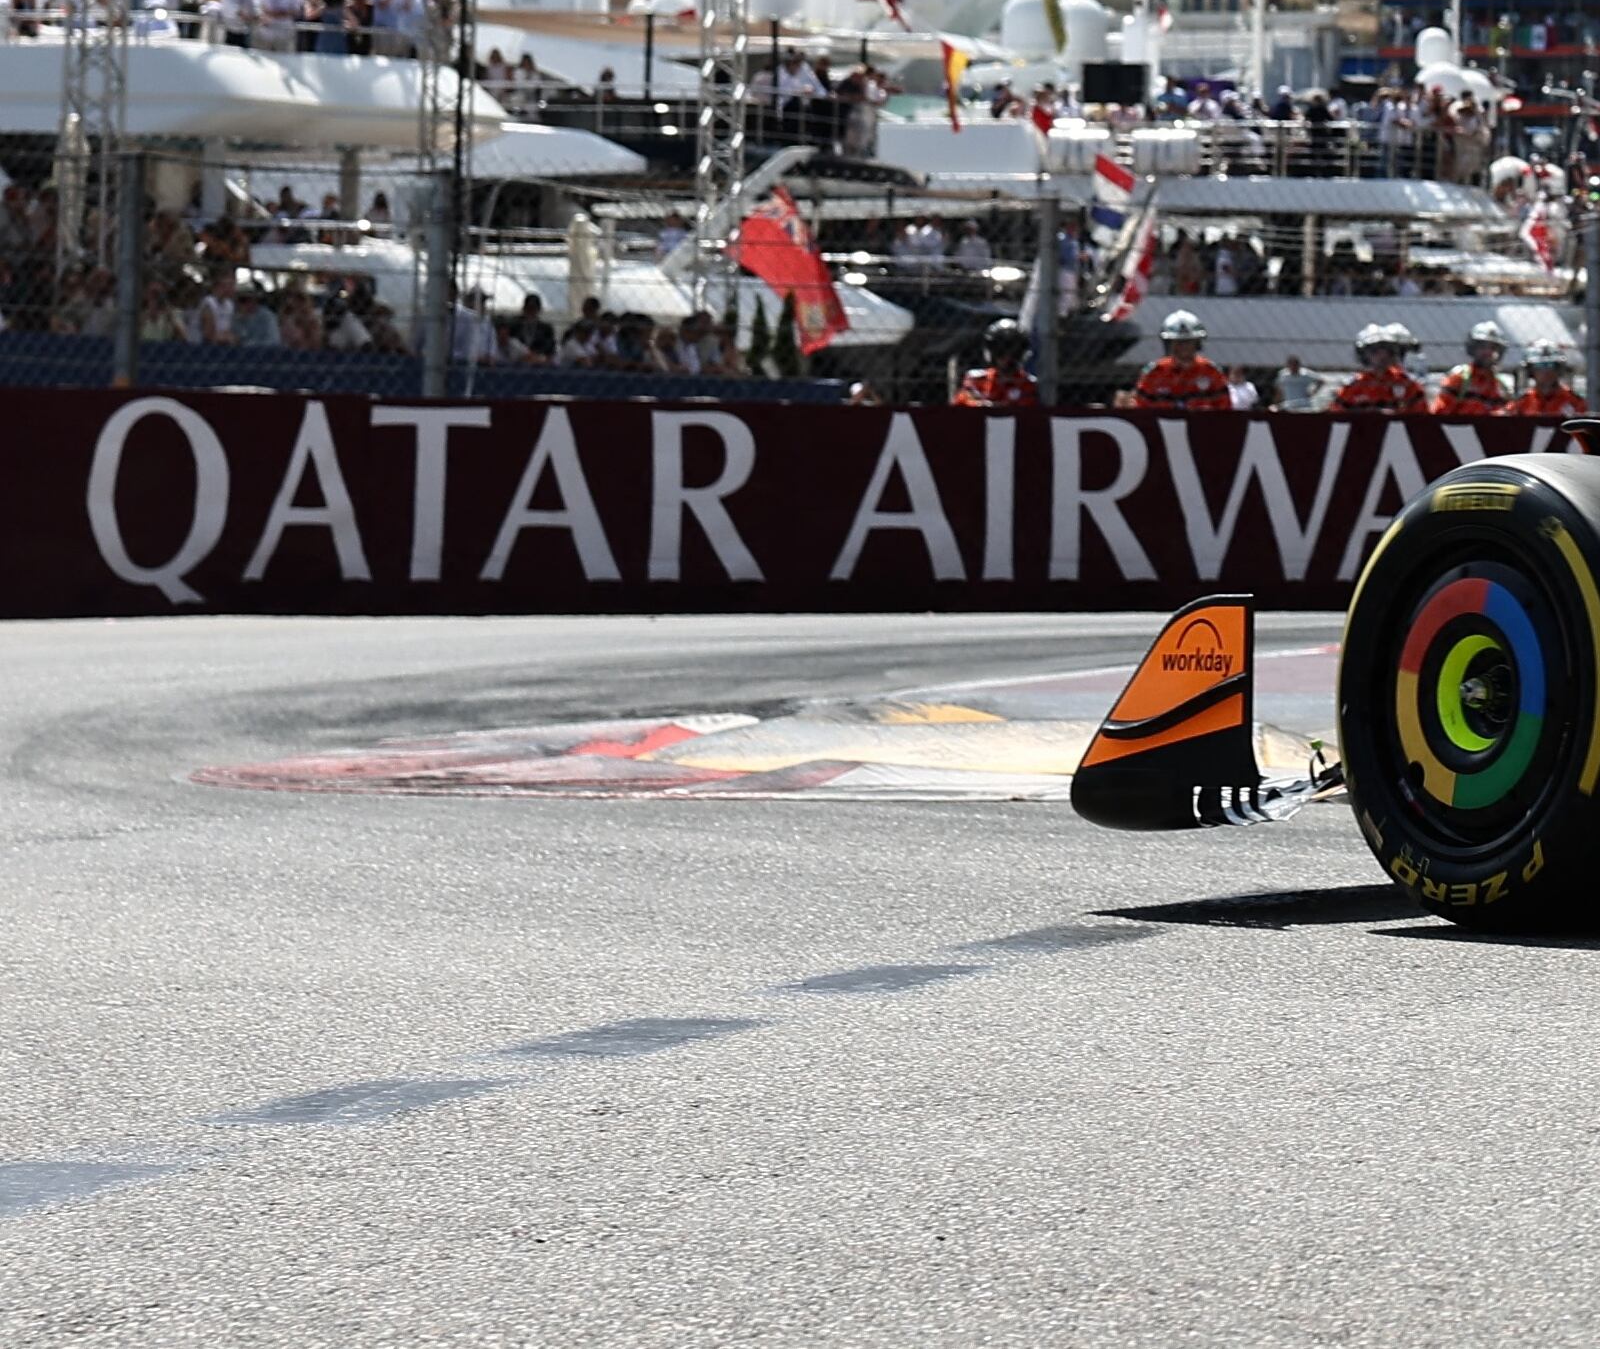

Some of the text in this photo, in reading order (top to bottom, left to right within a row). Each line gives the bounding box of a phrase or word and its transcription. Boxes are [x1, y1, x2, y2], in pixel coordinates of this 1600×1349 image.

[85, 396, 1585, 605] QATAR AIRWA
[1162, 647, 1233, 678] workday
[1391, 856, 1509, 906] ZERO
[1522, 839, 1545, 882] P
